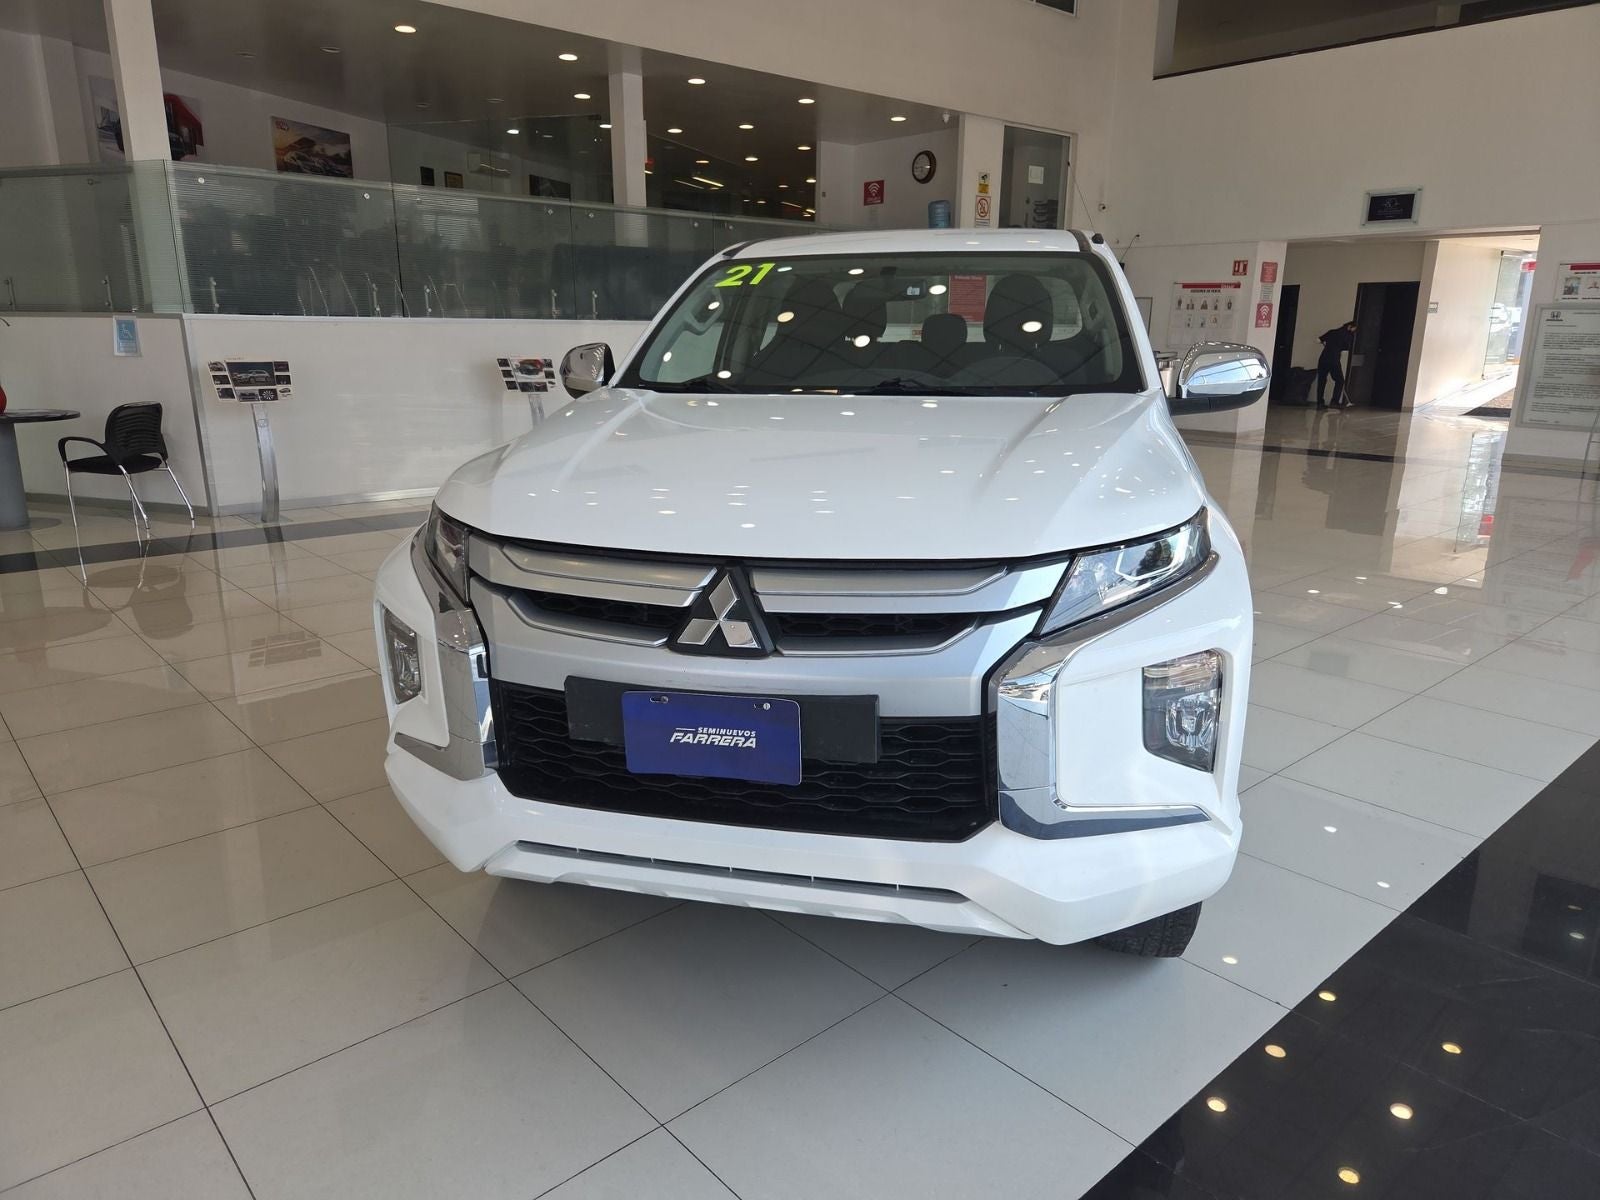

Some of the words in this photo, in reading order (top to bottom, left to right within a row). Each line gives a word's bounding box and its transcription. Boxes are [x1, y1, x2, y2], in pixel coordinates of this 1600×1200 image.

[714, 263, 776, 287] 21
[670, 732, 756, 748] FARRERA
[698, 727, 756, 737] SEMINUEVOS
